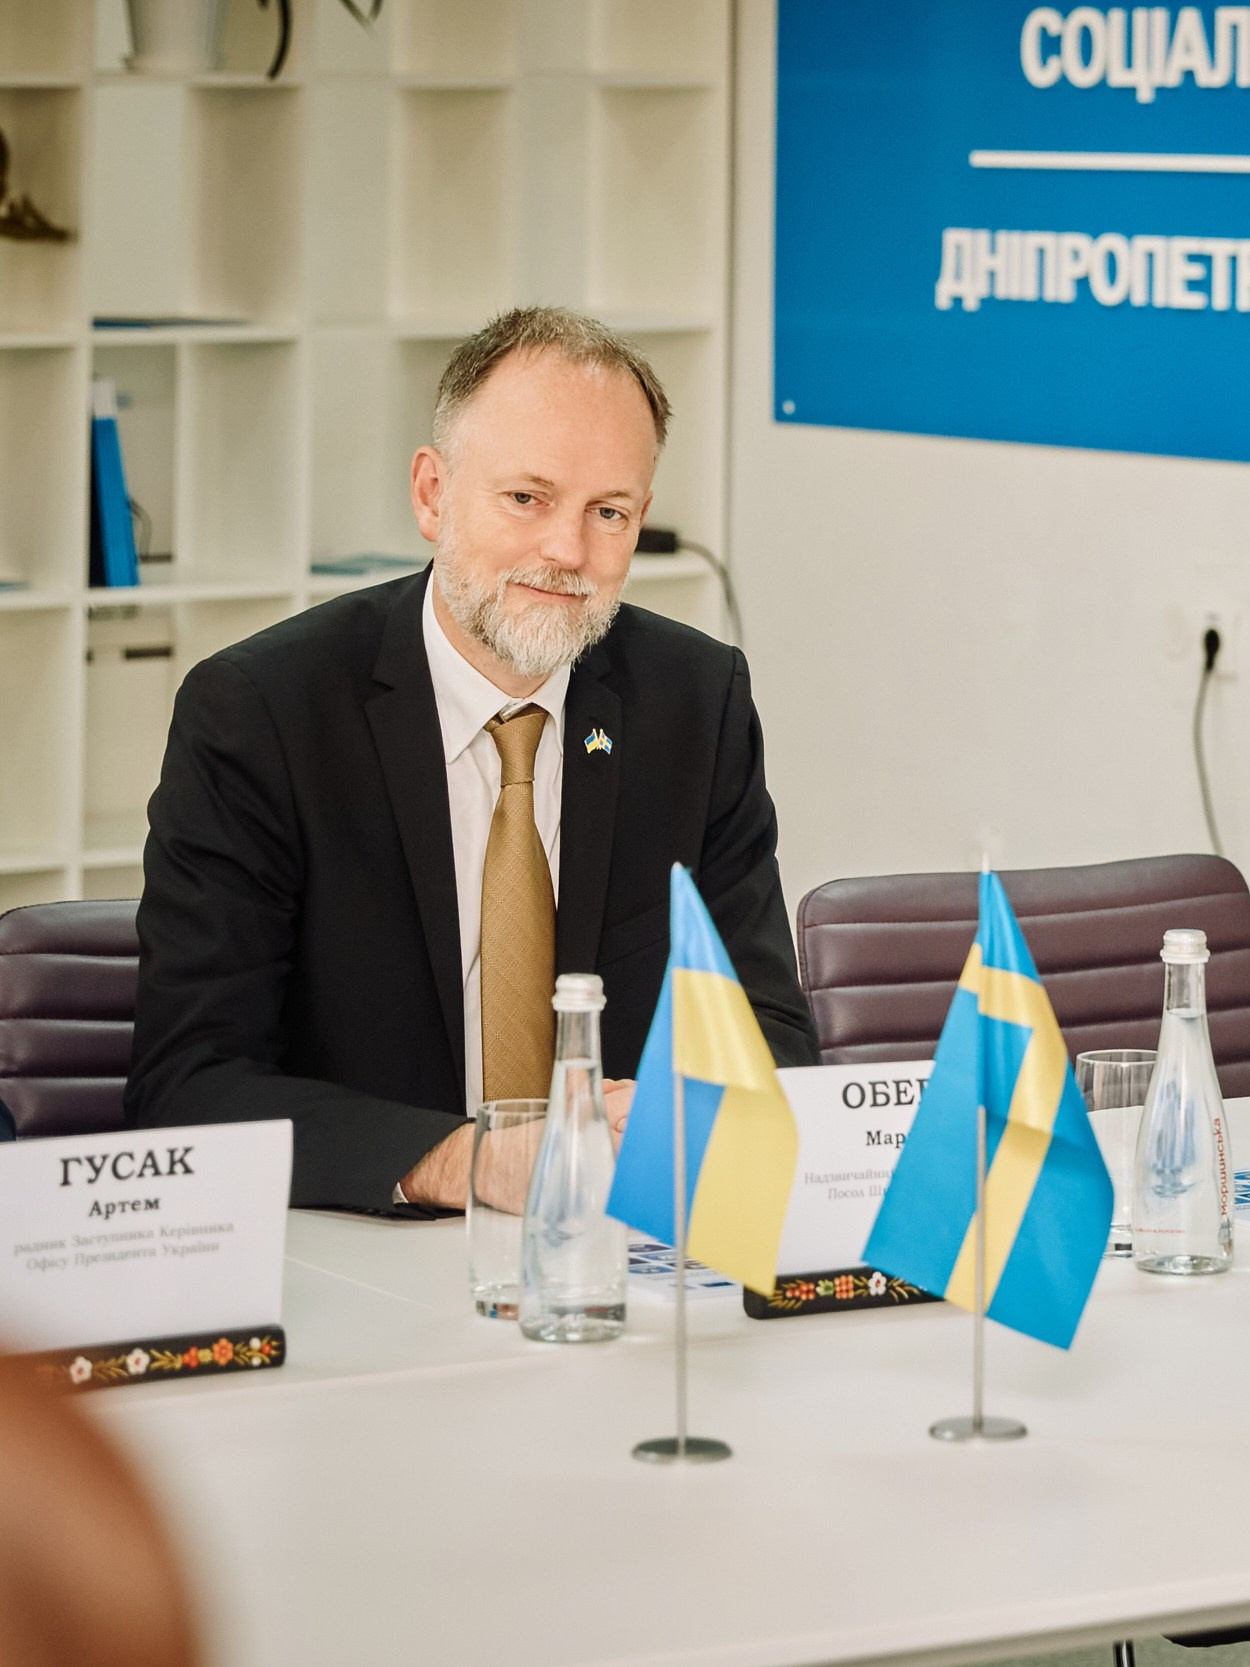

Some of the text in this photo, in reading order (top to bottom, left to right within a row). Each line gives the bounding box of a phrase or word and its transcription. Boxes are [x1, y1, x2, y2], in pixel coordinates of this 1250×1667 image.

[59, 1146, 195, 1187] ГУСАК
[804, 1168, 894, 1184] Надзвичайни
[1213, 1118, 1228, 1216] моршинська
[88, 1198, 160, 1220] Артем
[828, 1187, 865, 1199] Посол
[13, 1222, 234, 1257] радник Заступника Керівника
[26, 1241, 220, 1273] Офісу Президента України
